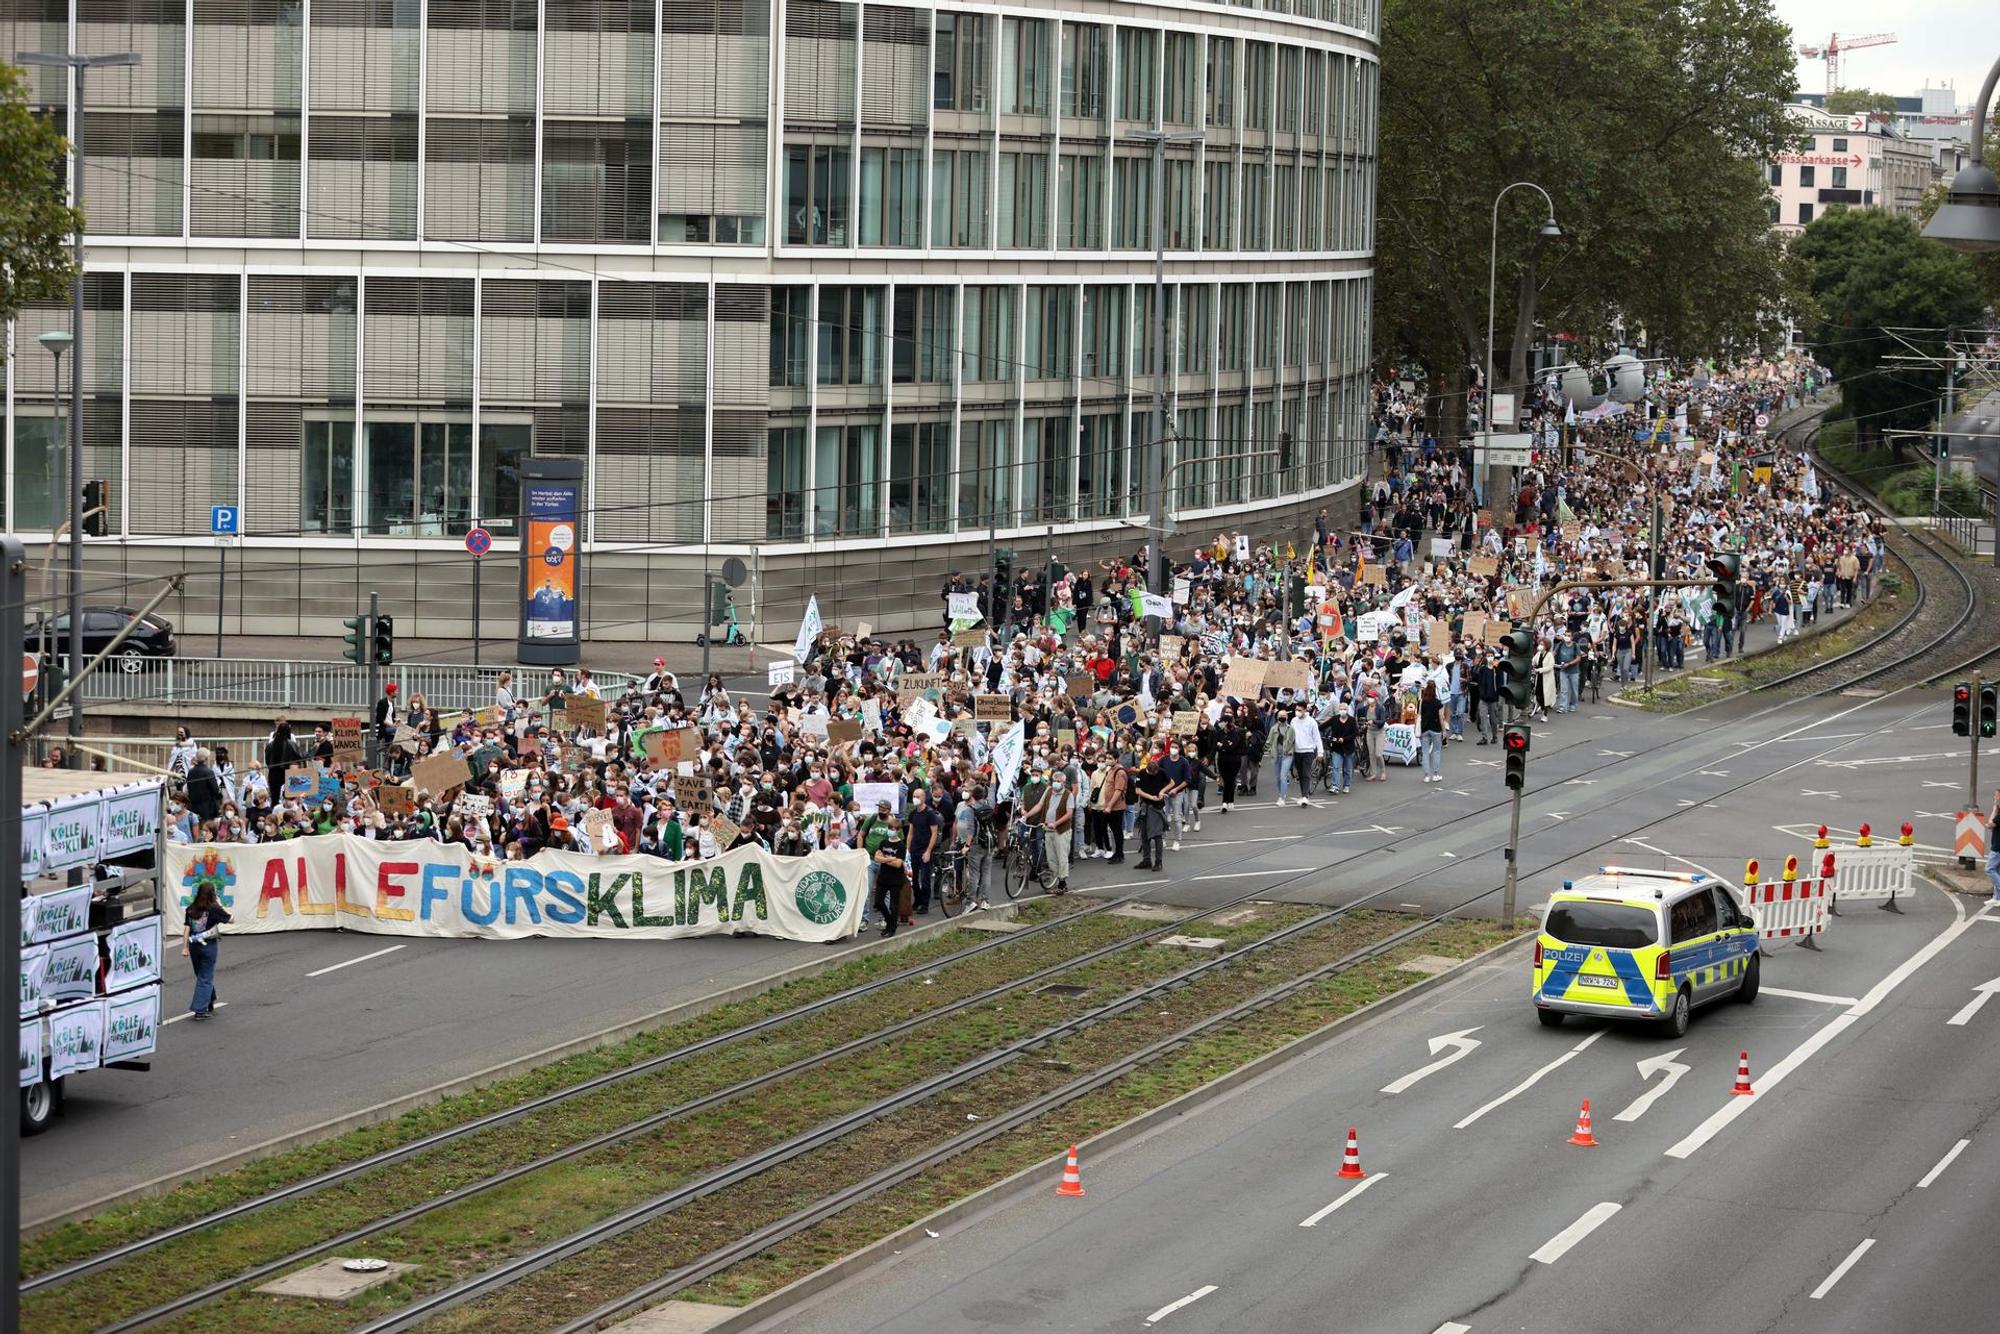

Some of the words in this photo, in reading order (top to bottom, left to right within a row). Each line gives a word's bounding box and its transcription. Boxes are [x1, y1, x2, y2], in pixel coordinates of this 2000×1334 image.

[217, 509, 232, 530] P
[773, 671, 790, 684] EIS
[904, 678, 941, 690] ZUKUNFT
[333, 719, 361, 728] POLITIK
[335, 729, 359, 737] KLIMA
[334, 741, 361, 749] WANDEL
[679, 779, 705, 788] SAVE
[678, 789, 694, 797] THE
[681, 800, 711, 811] EARTH
[110, 810, 138, 828] KÖLLE
[50, 822, 80, 842] KÖLLE
[796, 873, 819, 898] FRIDAYS
[821, 873, 837, 886] FOR
[40, 904, 69, 920] KÖLLE
[815, 901, 846, 923] FUTURE
[1543, 950, 1584, 962] POLIZEI
[49, 957, 76, 975] KÖLLE
[111, 1014, 139, 1033] KÖLLE
